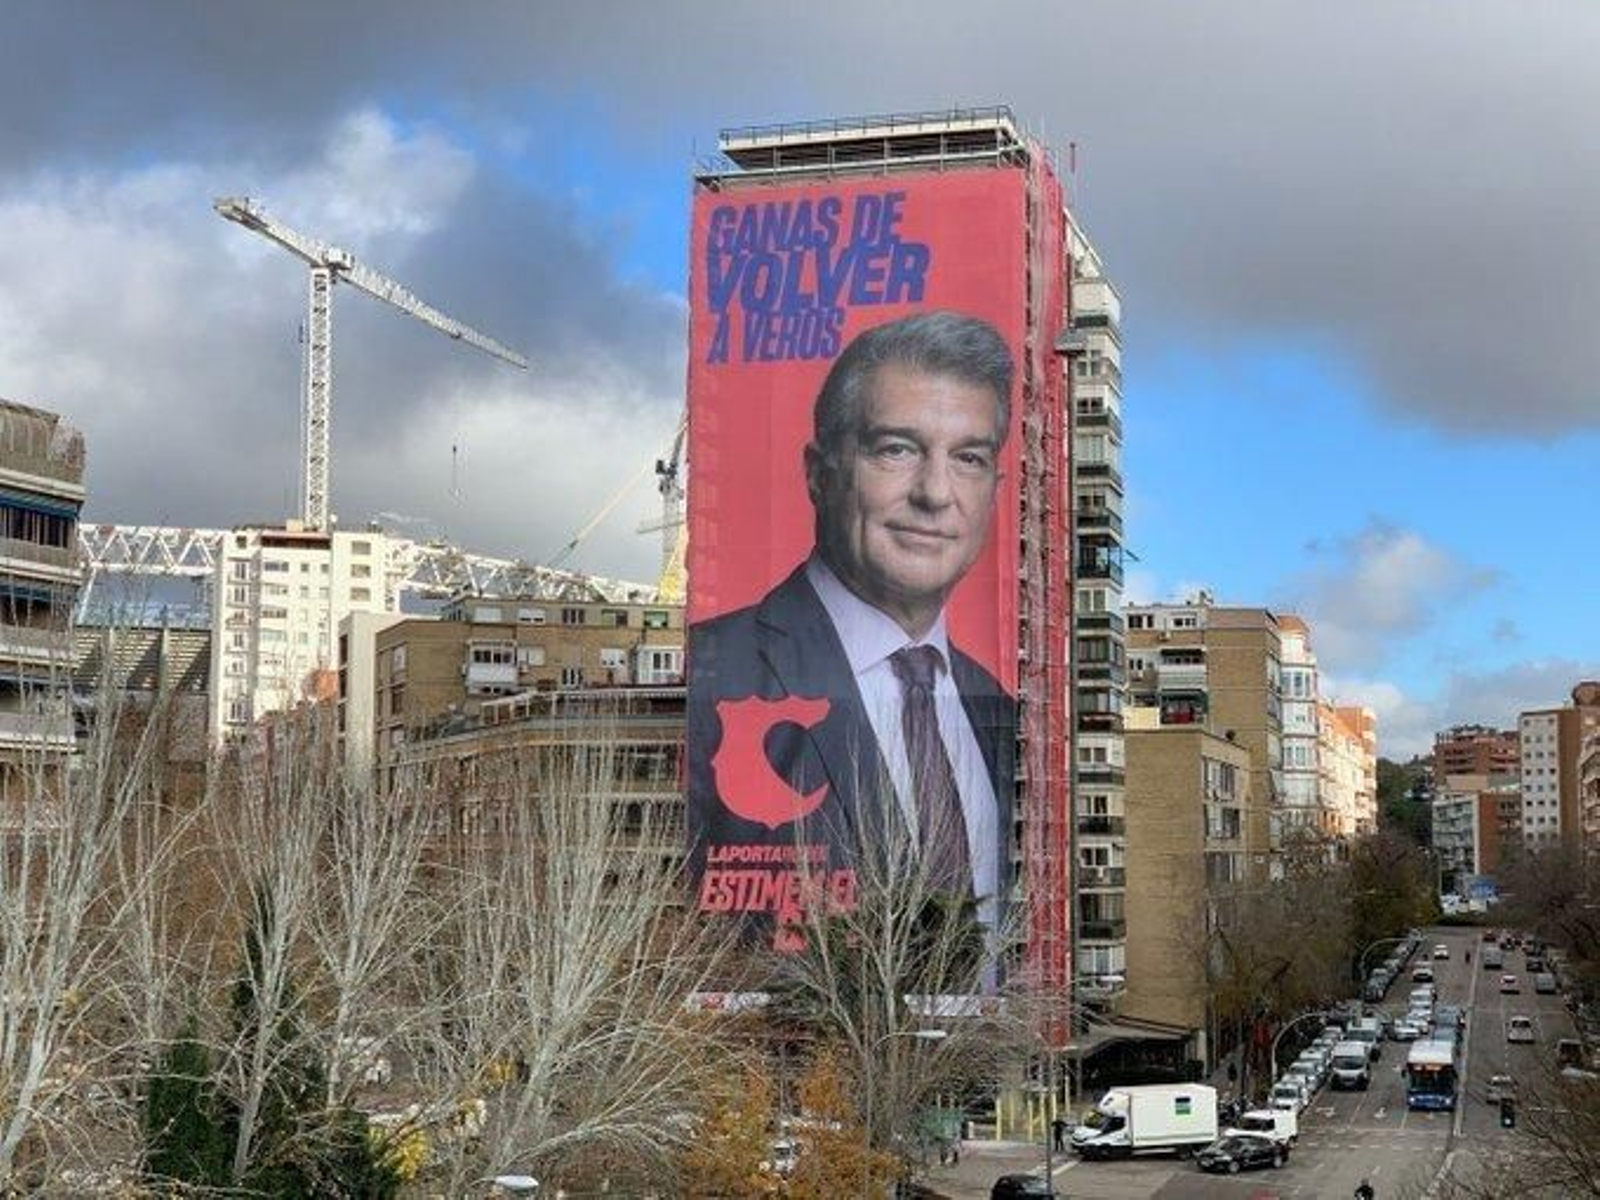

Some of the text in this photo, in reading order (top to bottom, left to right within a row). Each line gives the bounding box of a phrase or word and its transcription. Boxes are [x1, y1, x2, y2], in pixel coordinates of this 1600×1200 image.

[708, 190, 905, 254] GANAS DE
[707, 242, 931, 313] VOLVER
[706, 307, 845, 365] A VEROS
